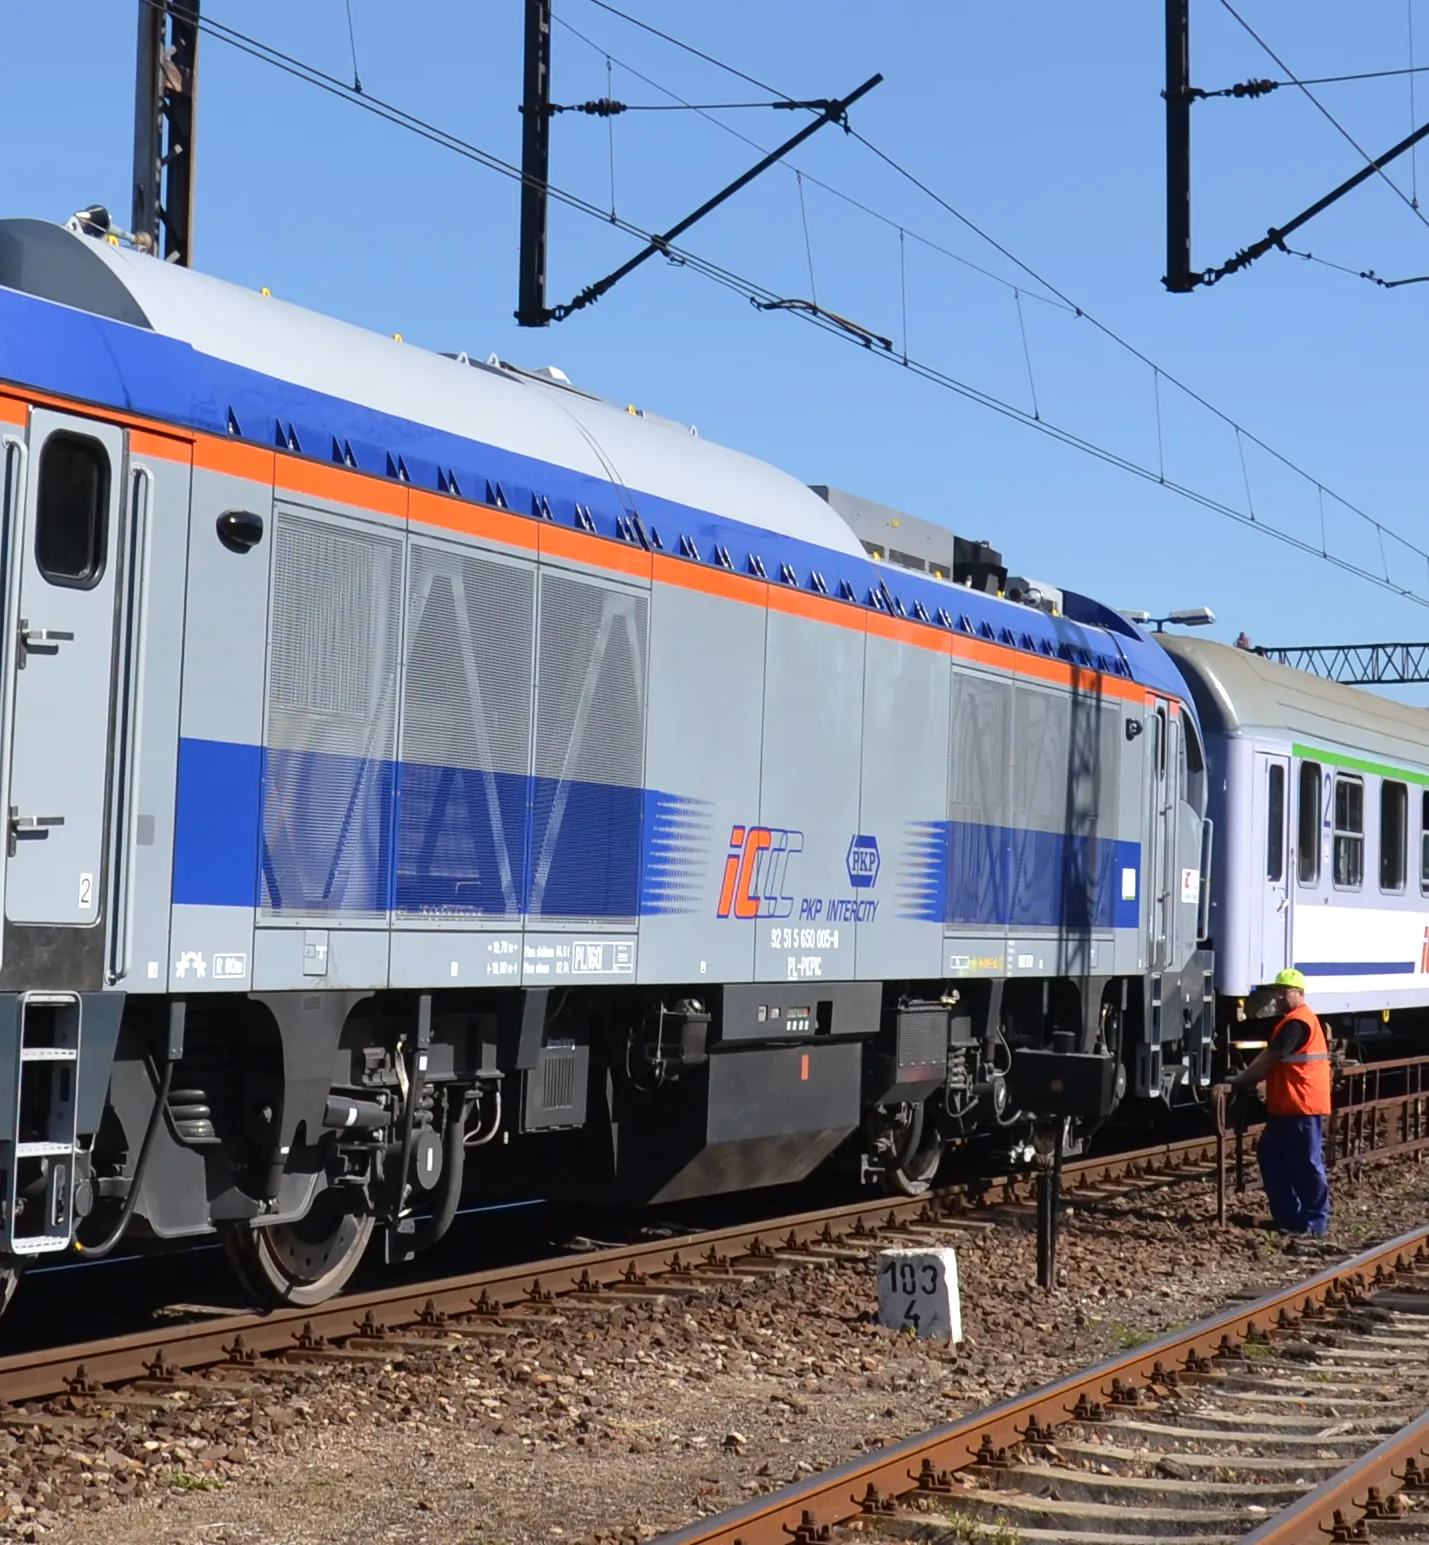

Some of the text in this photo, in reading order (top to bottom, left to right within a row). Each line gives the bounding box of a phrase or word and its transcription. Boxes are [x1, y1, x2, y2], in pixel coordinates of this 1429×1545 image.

[1323, 772, 1332, 828] 2
[852, 851, 876, 873] PKP
[81, 878, 90, 903] 2
[799, 898, 879, 922] PKP INTERCITY
[771, 928, 782, 949] 92
[793, 928, 800, 949] 5
[883, 1261, 938, 1296] 103
[903, 1299, 920, 1331] 4
